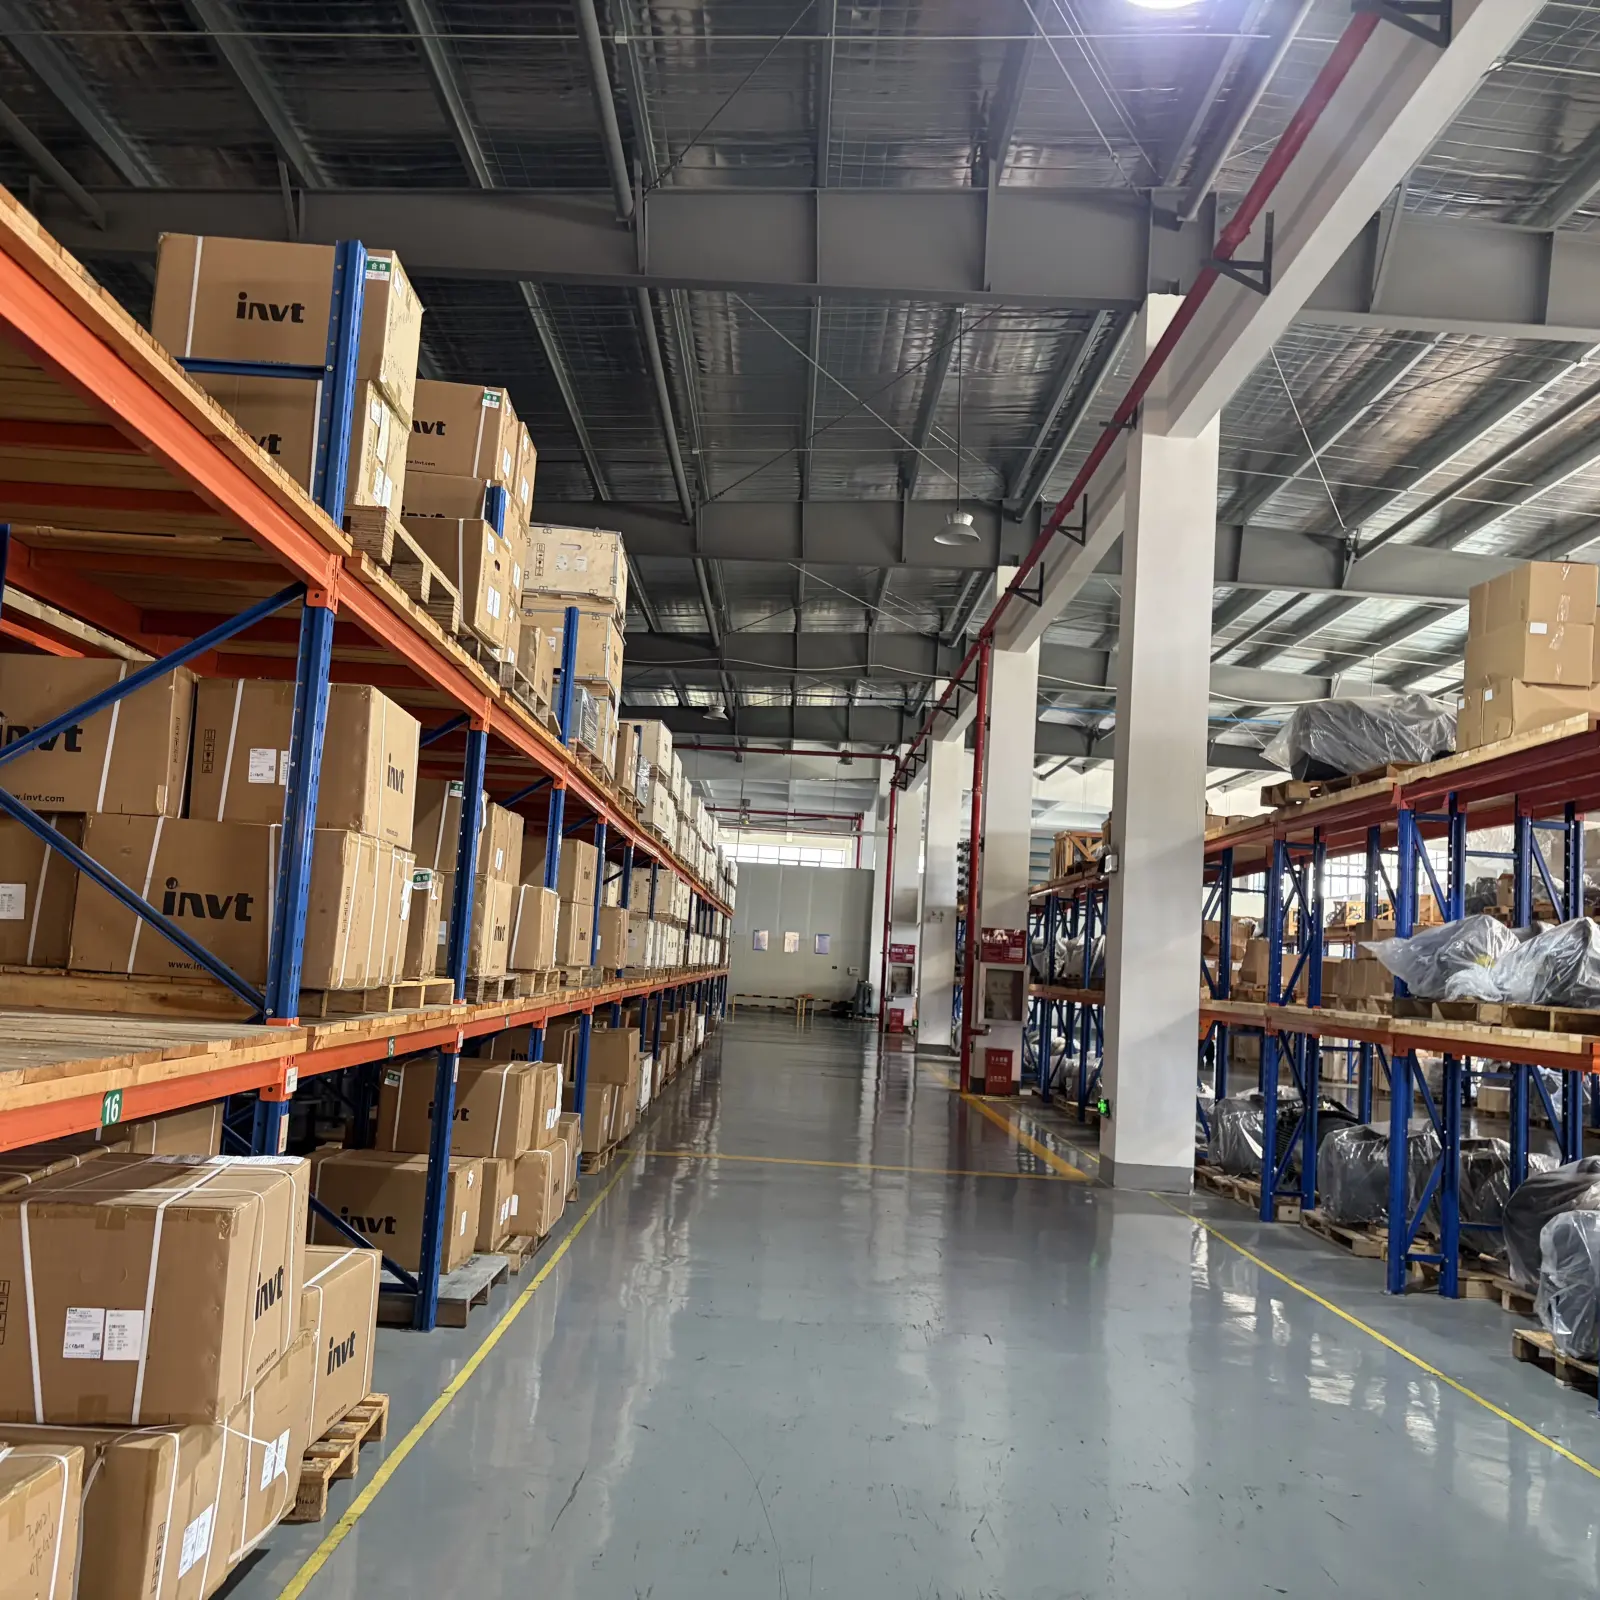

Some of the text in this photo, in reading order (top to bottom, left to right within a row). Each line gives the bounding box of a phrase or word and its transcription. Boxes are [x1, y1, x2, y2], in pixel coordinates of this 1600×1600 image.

[236, 291, 305, 323] invt
[387, 752, 405, 795] invt
[162, 877, 254, 922] invt
[105, 1093, 120, 1125] 16
[340, 1206, 397, 1235] invt
[255, 1265, 284, 1322] invt
[326, 1330, 356, 1376] invt
